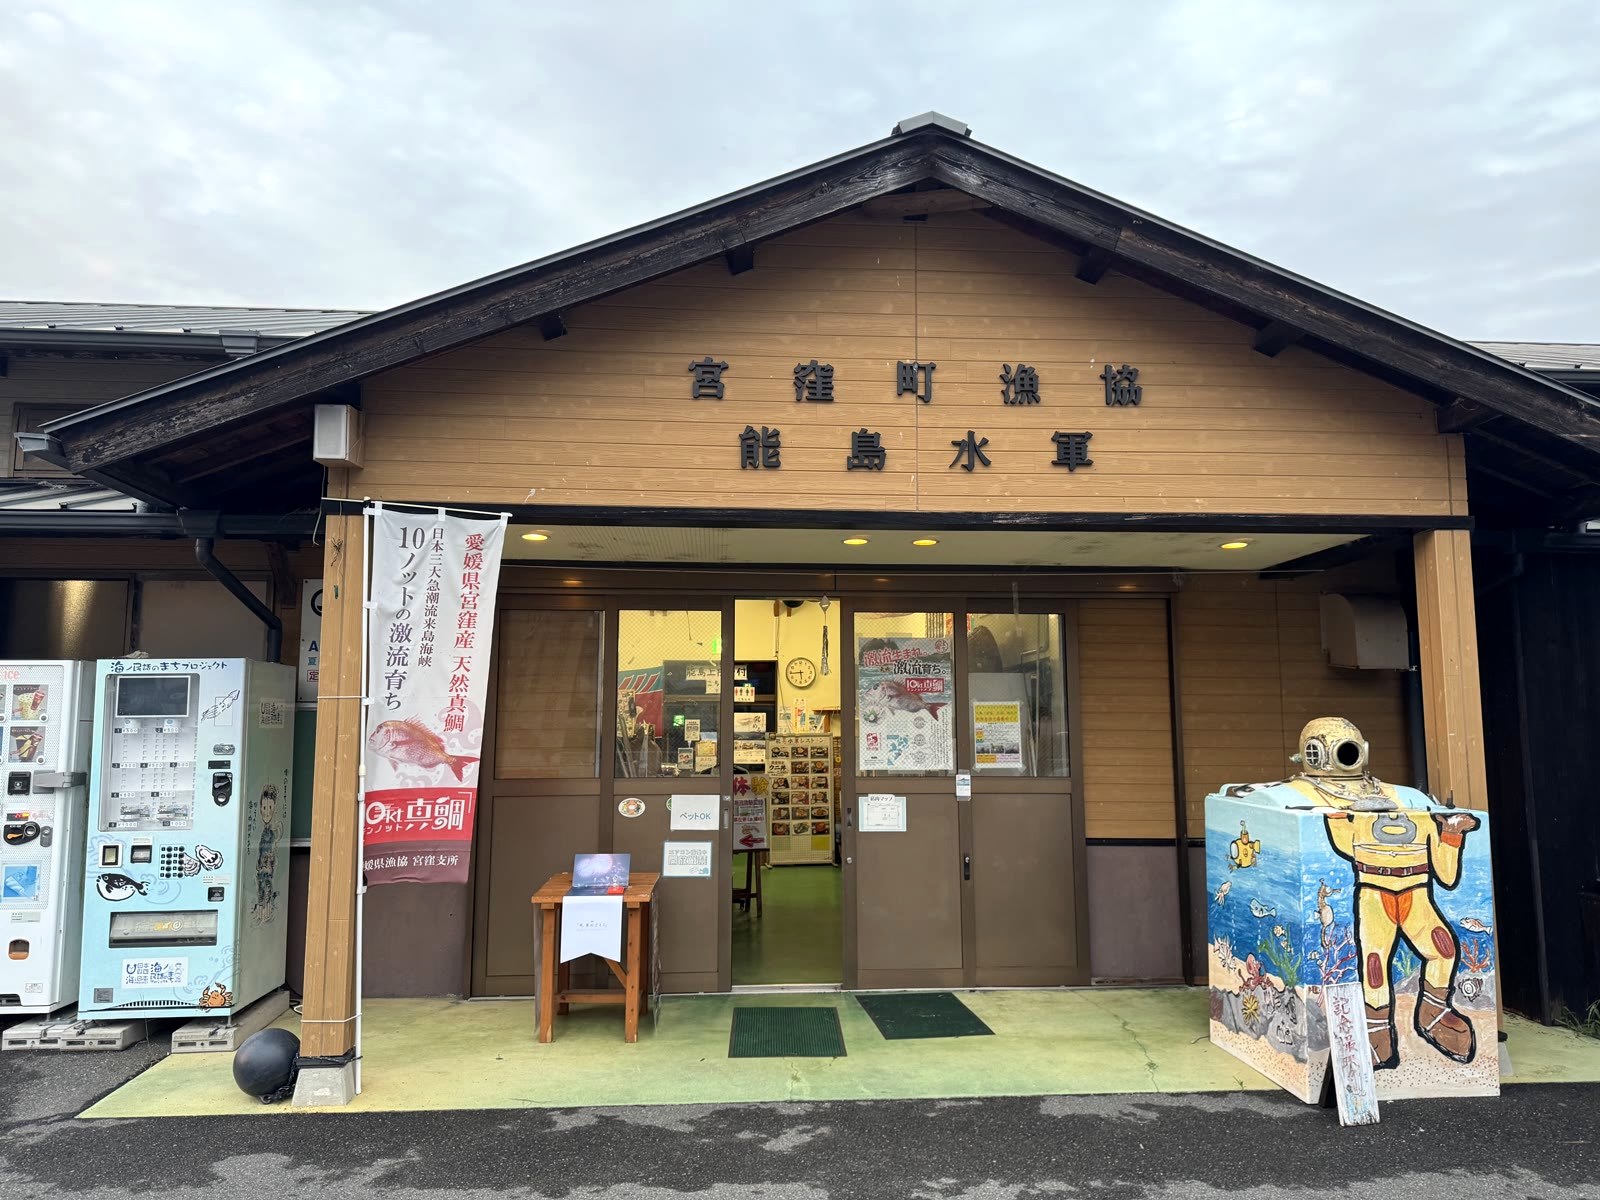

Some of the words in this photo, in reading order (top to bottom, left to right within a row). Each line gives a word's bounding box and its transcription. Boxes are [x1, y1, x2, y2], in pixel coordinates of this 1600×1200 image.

[688, 356, 1142, 407] 宮窪町漁協
[738, 425, 1094, 472] 能島水軍
[384, 526, 425, 711] 10ノットの激流育ち
[417, 527, 444, 668] 日本三大急潮流来島海峡
[453, 532, 485, 649] 愛媛県宮窪産
[443, 655, 472, 733] 天然真鯛
[679, 812, 711, 820] ペットOK
[362, 855, 409, 871] 媛県漁協
[412, 854, 459, 866] 宮窪支所
